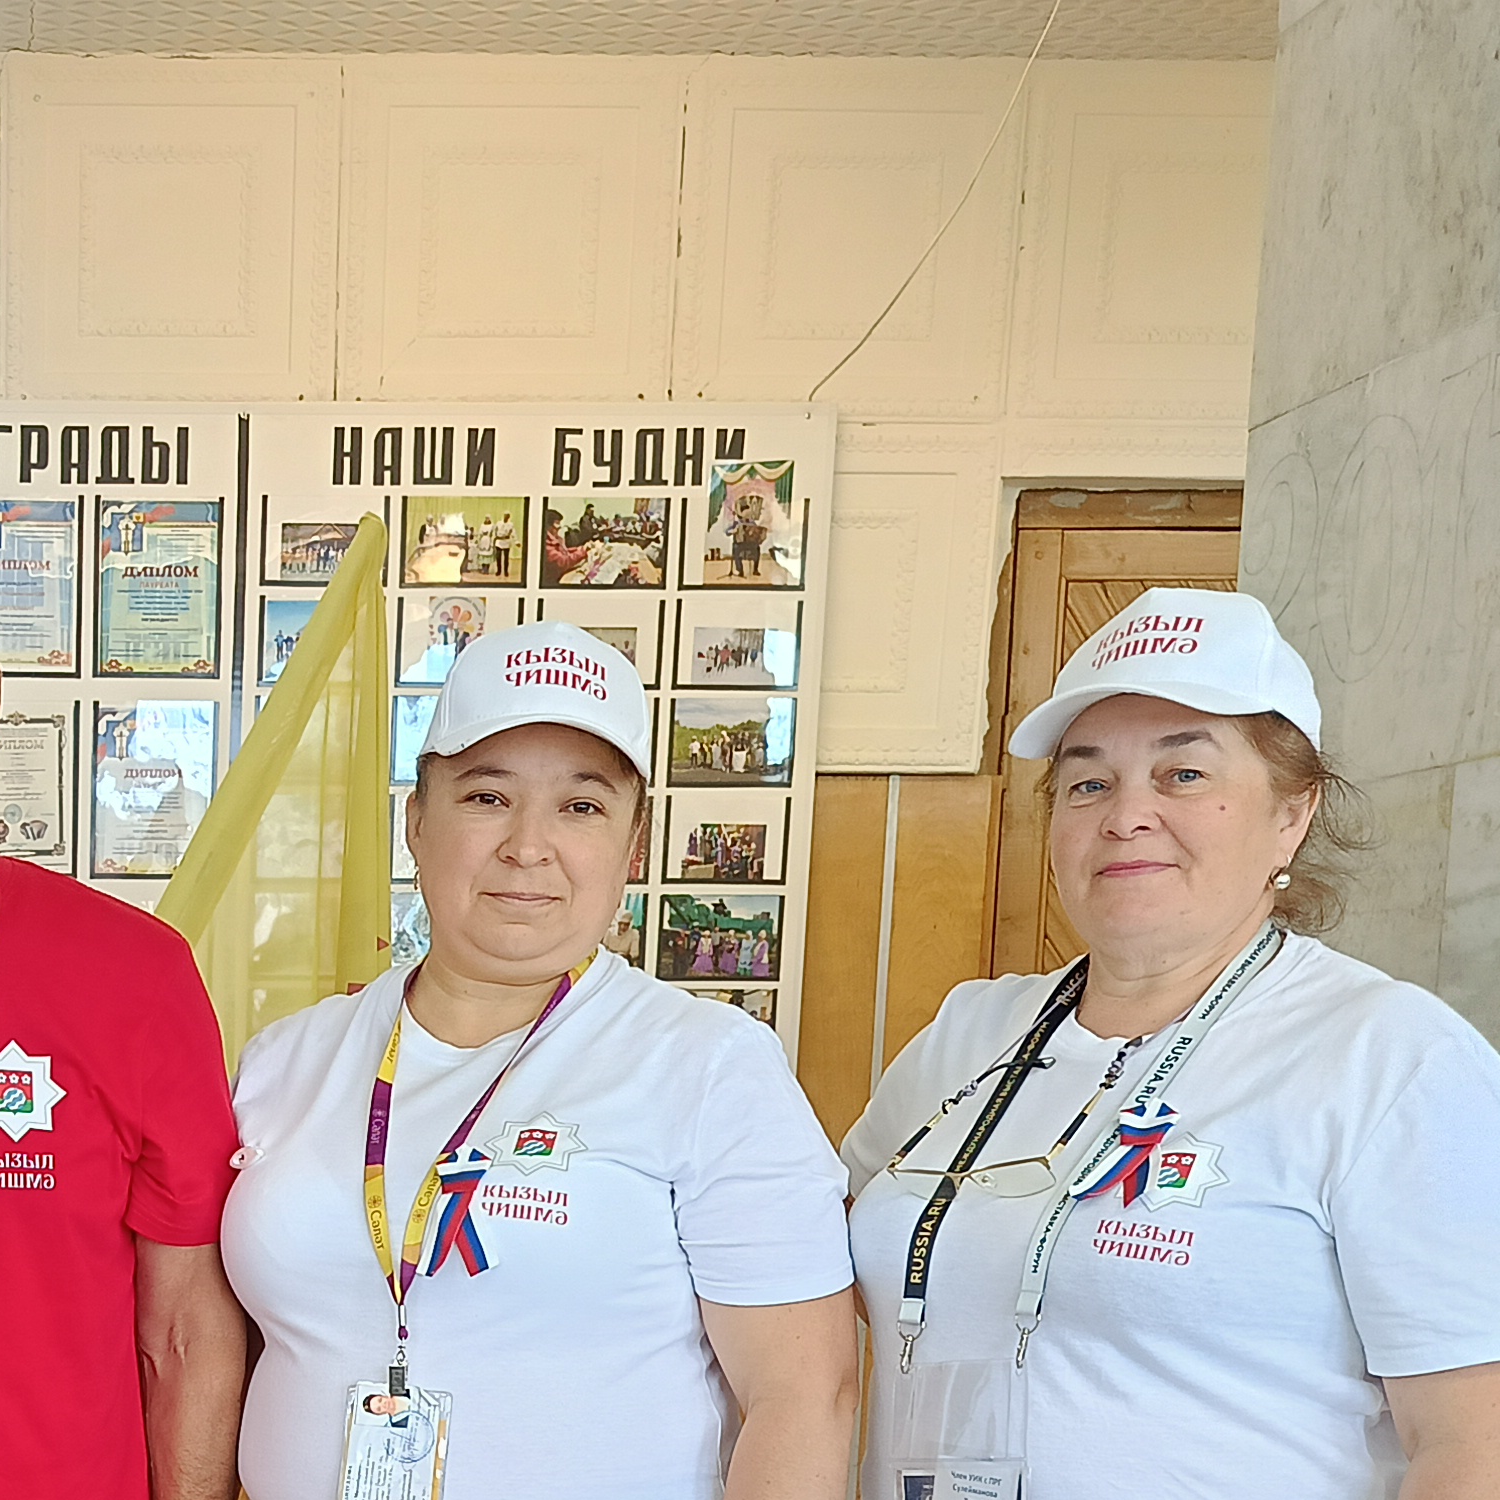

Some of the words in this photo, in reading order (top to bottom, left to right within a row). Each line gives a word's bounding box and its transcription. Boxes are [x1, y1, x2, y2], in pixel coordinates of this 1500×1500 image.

[332, 426, 496, 486] НАШИ
[122, 565, 199, 579] ДИПЛОМ
[1095, 615, 1204, 654] КЫЗЫЛ
[505, 646, 606, 682] КЫЗЫЛ
[1134, 1036, 1193, 1106] RUSSIA.RU
[482, 1184, 568, 1207] КЫЗЫЛ
[481, 1202, 568, 1226] ЧИШМӘ
[910, 1197, 948, 1284] RUSSIA.RU
[1096, 1219, 1194, 1247] КЫЗЫЛ
[1093, 1238, 1190, 1266] ЧИШМӘ
